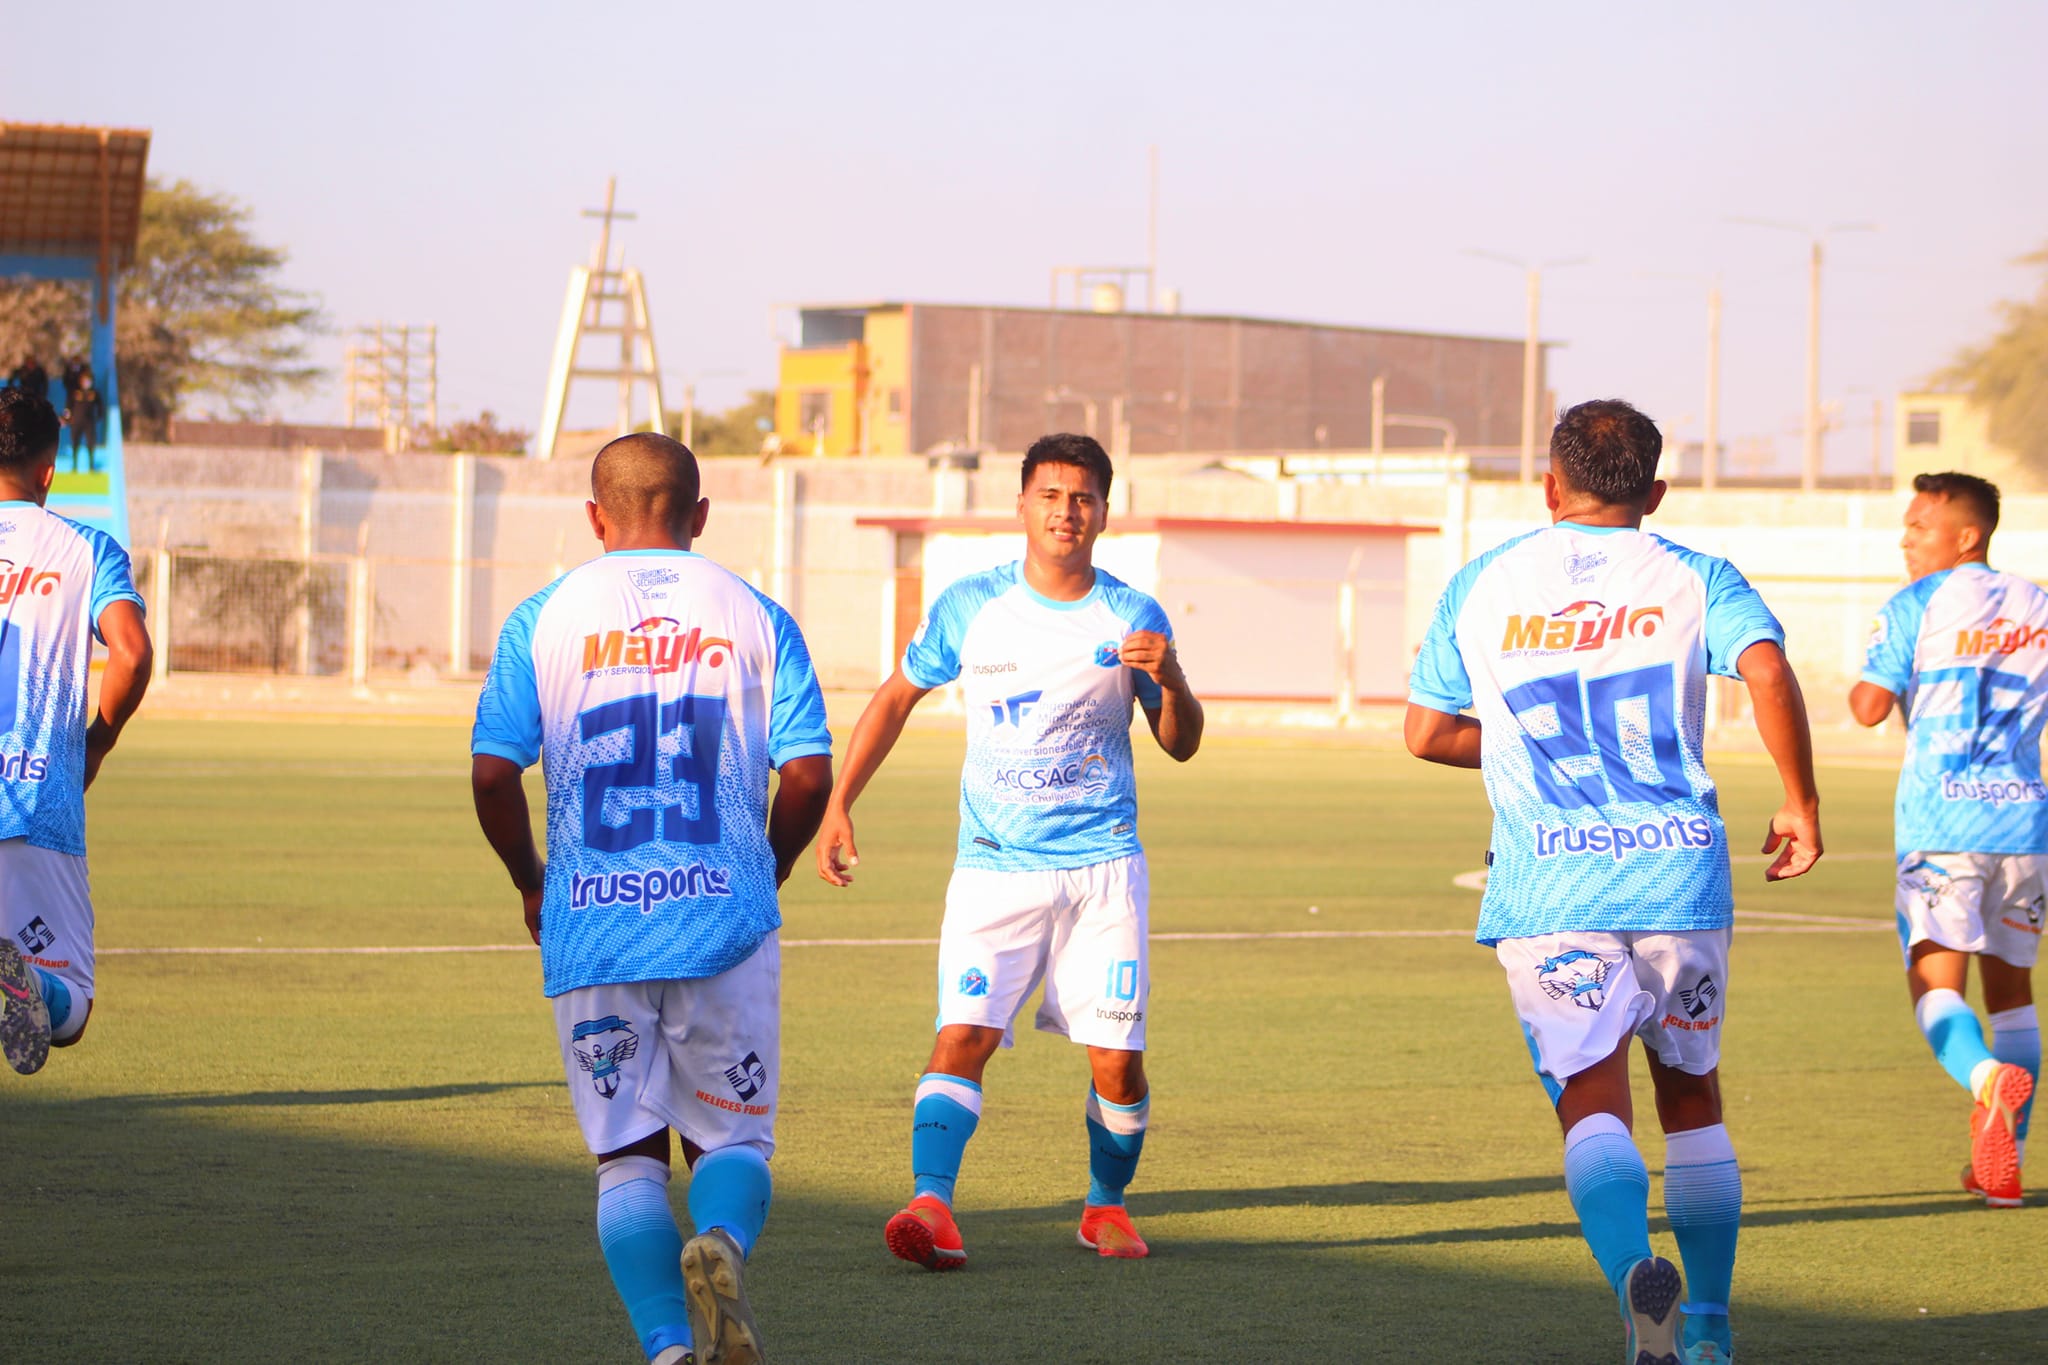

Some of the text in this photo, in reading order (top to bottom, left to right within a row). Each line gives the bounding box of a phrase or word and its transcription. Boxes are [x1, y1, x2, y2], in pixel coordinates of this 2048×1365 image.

[582, 627, 733, 676] Maylo
[1501, 605, 1664, 652] Maylo
[1502, 662, 1693, 811] 20
[579, 692, 728, 856] 23
[993, 764, 1078, 790] ACCSAC
[1536, 815, 1712, 860] trusports
[572, 861, 731, 913] trusports
[34, 956, 70, 969] FRANCO
[1105, 959, 1138, 1001] 10
[696, 1089, 742, 1113] HELICES
